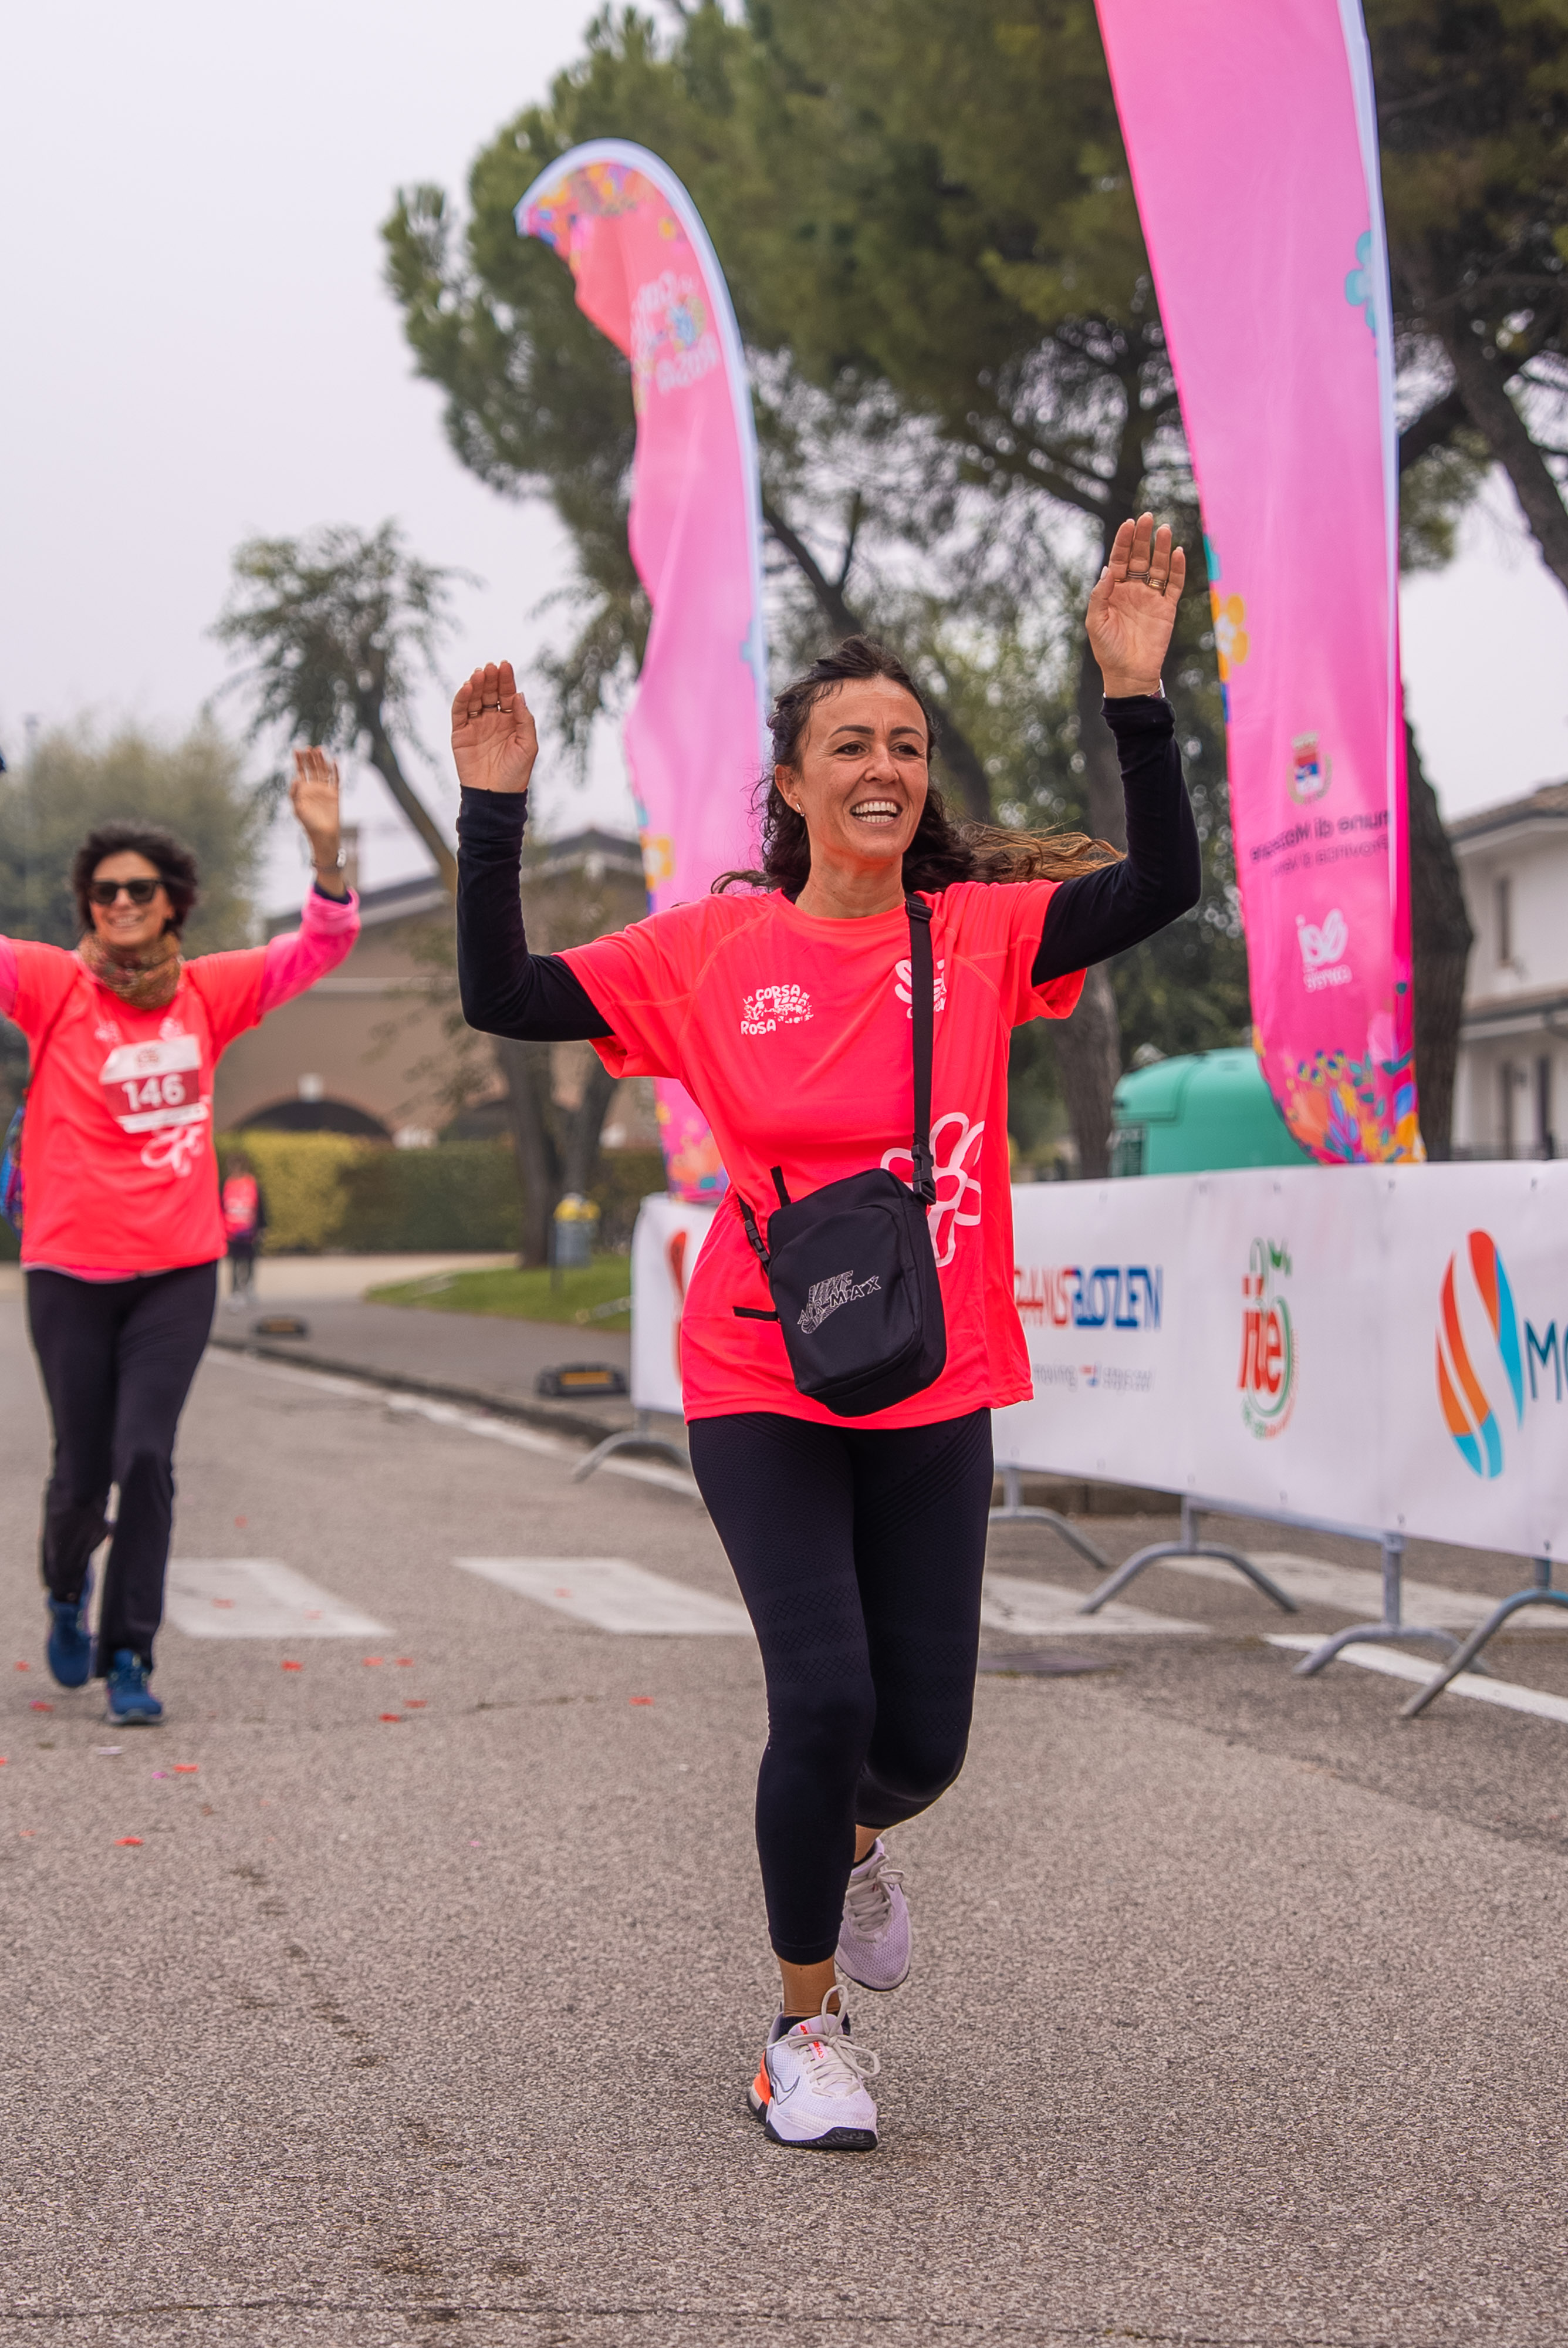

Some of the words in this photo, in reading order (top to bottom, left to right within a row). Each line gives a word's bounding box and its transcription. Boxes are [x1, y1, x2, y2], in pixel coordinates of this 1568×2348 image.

[742, 996, 754, 1004] LA
[755, 984, 800, 1001] CORSA
[741, 1019, 776, 1035] ROSA
[121, 1074, 185, 1111] 146
[830, 1275, 881, 1308] MAX
[1524, 1318, 1568, 1402] M
